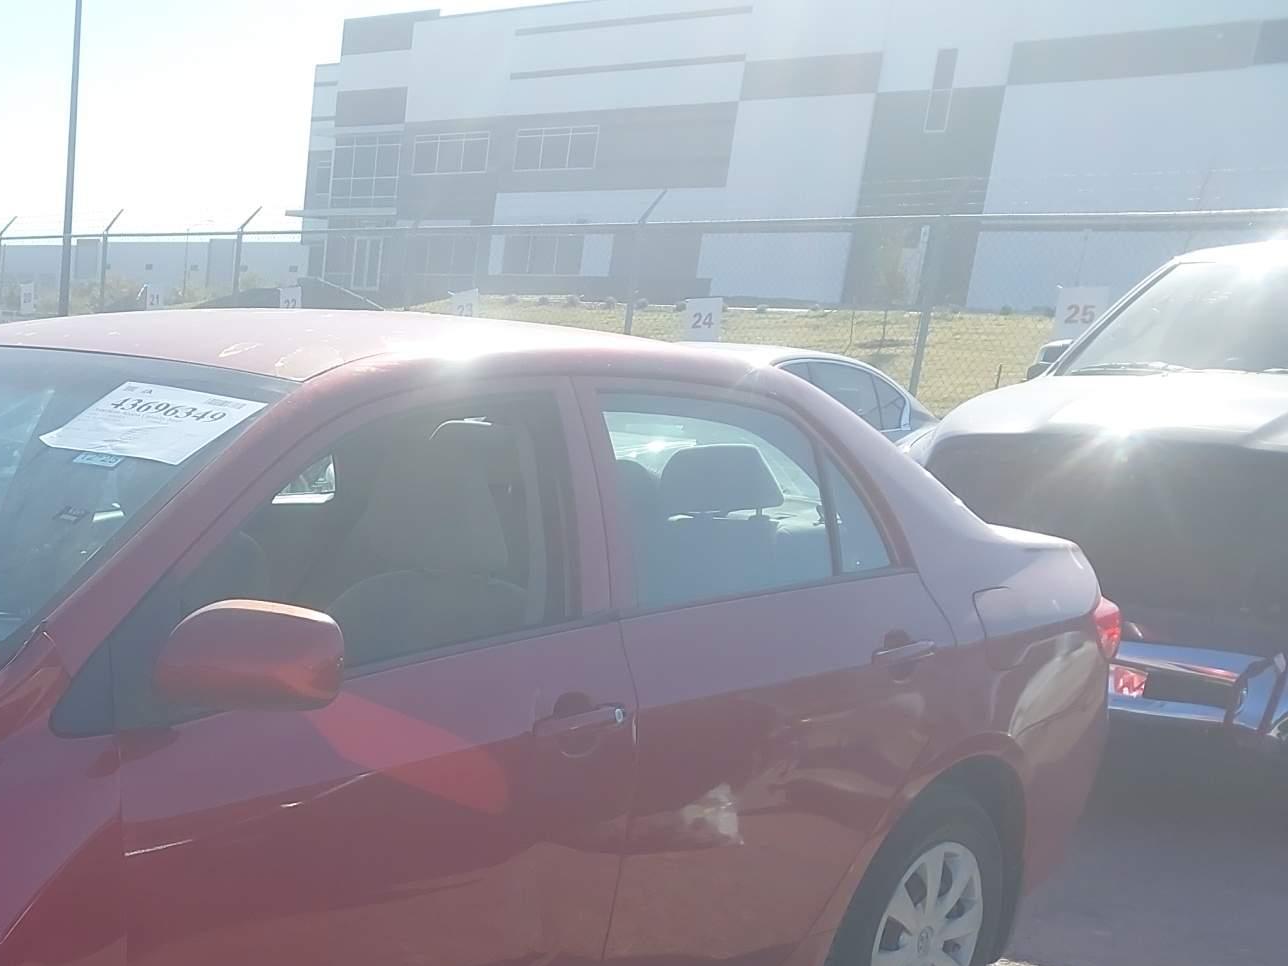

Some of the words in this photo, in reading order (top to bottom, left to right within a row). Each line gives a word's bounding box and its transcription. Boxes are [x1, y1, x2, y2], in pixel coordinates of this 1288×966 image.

[692, 312, 714, 328] 24
[1064, 304, 1096, 324] 25
[111, 397, 227, 423] 43696349
